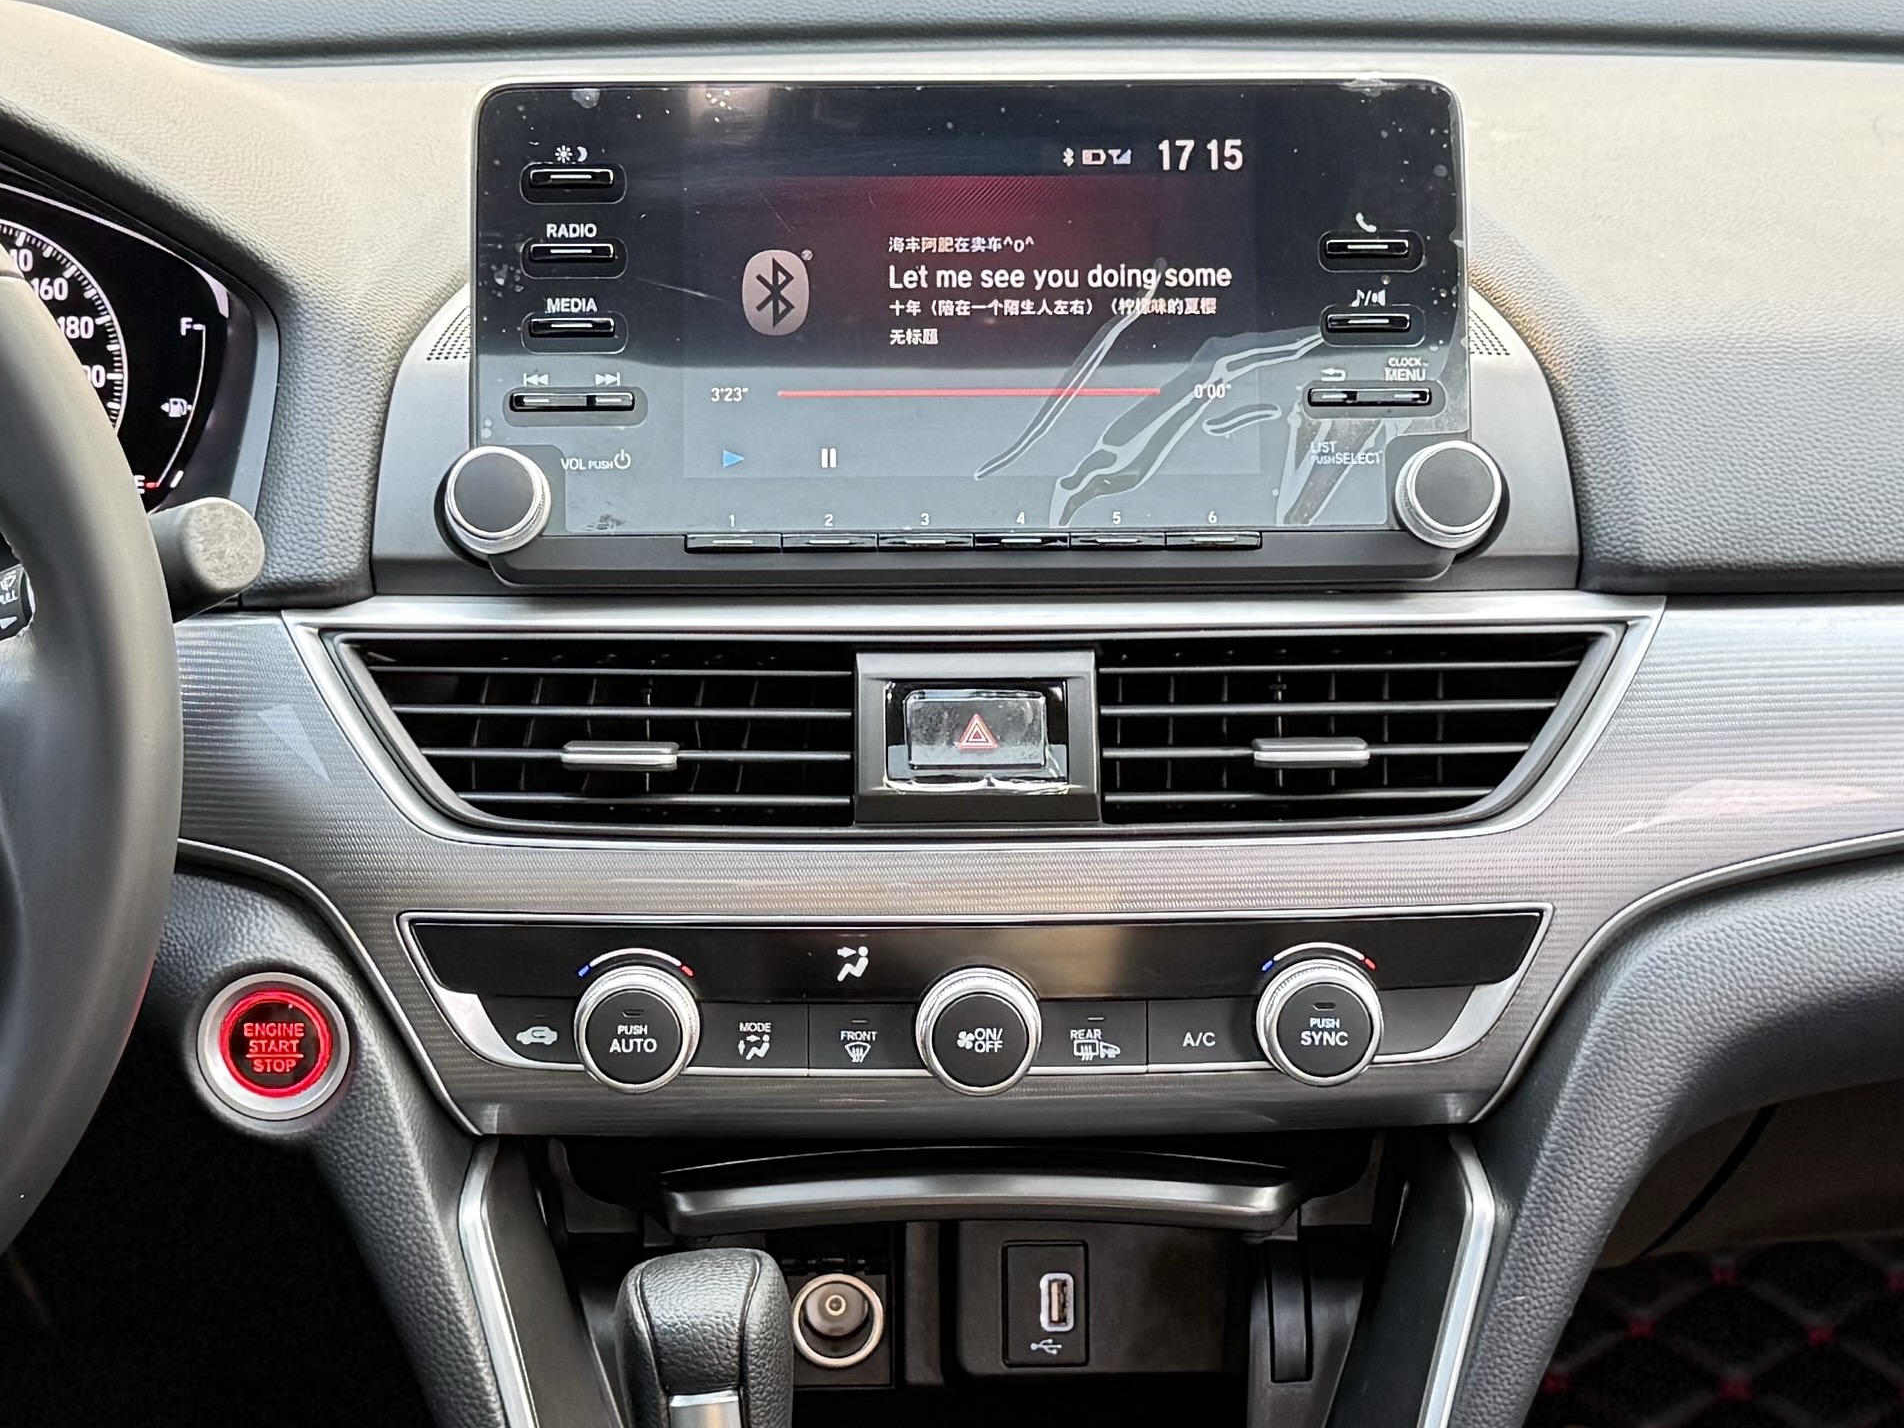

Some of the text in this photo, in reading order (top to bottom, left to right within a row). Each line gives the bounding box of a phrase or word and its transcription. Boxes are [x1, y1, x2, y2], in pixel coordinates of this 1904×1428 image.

[546, 223, 597, 238] RADIO
[889, 264, 1232, 291] Let me see you doing some
[546, 297, 598, 313] MEDIA
[180, 317, 193, 336] F
[889, 328, 939, 345] 无标题
[1388, 357, 1423, 367] CLOCK
[1384, 367, 1426, 381] MENU
[1310, 441, 1338, 453] LIST
[560, 458, 613, 471] VOL PUSH
[729, 514, 735, 528] 1
[824, 514, 834, 527] 2
[921, 513, 930, 526] 3
[1016, 512, 1026, 526] 4
[1112, 511, 1122, 525] 5
[1208, 510, 1217, 524] 6
[243, 1022, 305, 1038] ENGINE
[617, 1025, 648, 1036] PUSH
[739, 1022, 771, 1033] MODE
[1310, 1018, 1340, 1029] PUSH
[840, 1030, 878, 1041] FRONT
[1070, 1029, 1102, 1040] REAR
[1182, 1032, 1216, 1048] A/C
[1300, 1031, 1349, 1047] SYNC
[249, 1039, 300, 1052] START
[609, 1038, 657, 1054] AUTO
[974, 1040, 1003, 1053] OFF
[253, 1059, 296, 1073] STOP
